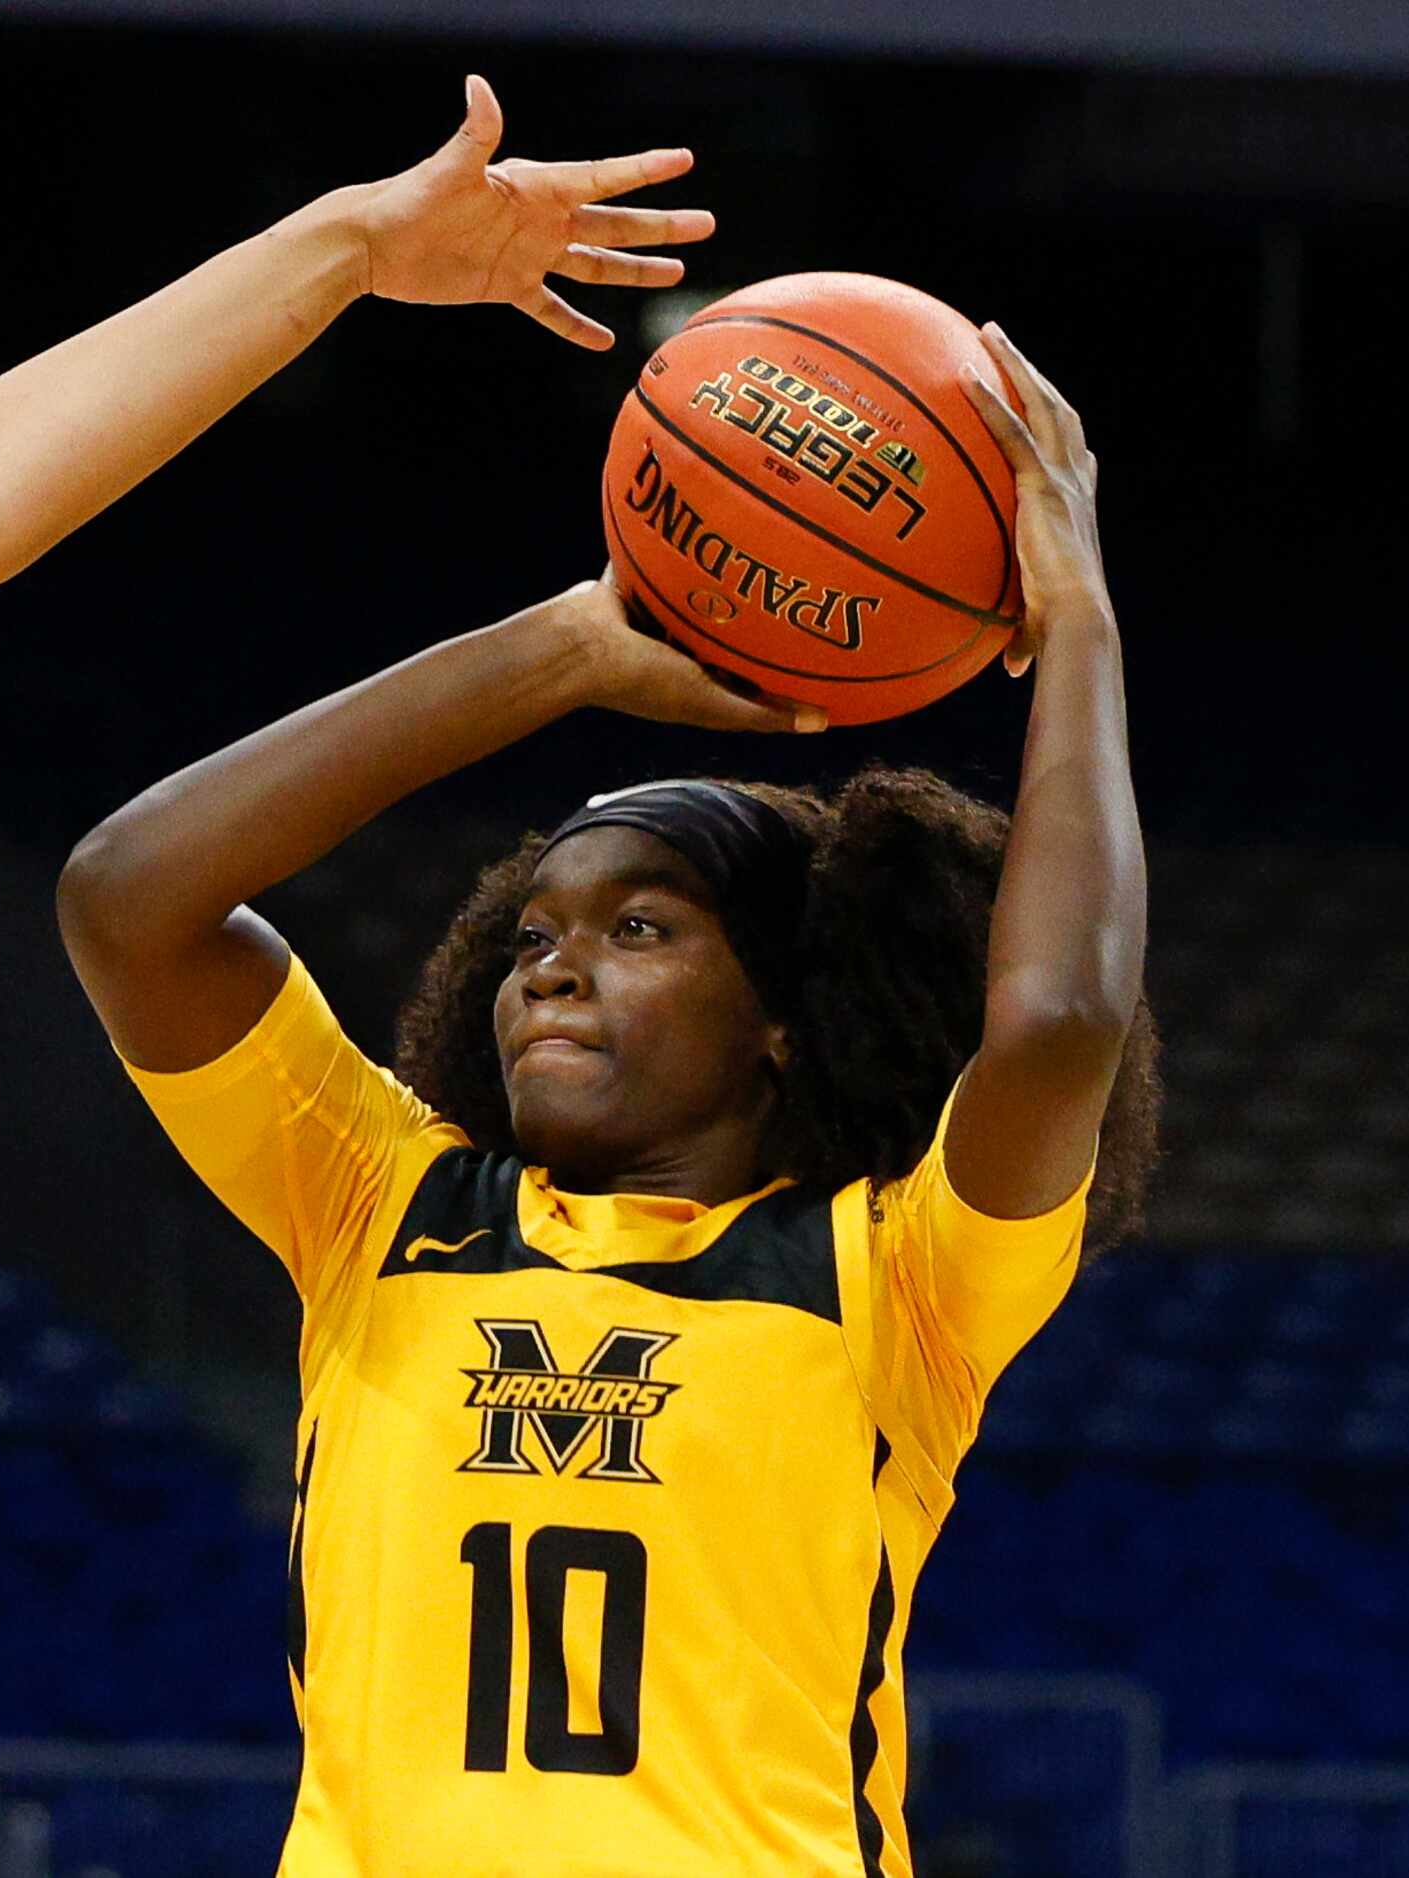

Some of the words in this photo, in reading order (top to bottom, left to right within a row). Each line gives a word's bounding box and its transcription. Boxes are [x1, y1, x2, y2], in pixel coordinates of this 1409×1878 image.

[689, 372, 928, 541] LEGACY
[736, 355, 880, 449] 1000
[625, 447, 884, 651] SPALDING
[472, 1373, 670, 1415] WARRIORS
[459, 1520, 648, 1777] 10
